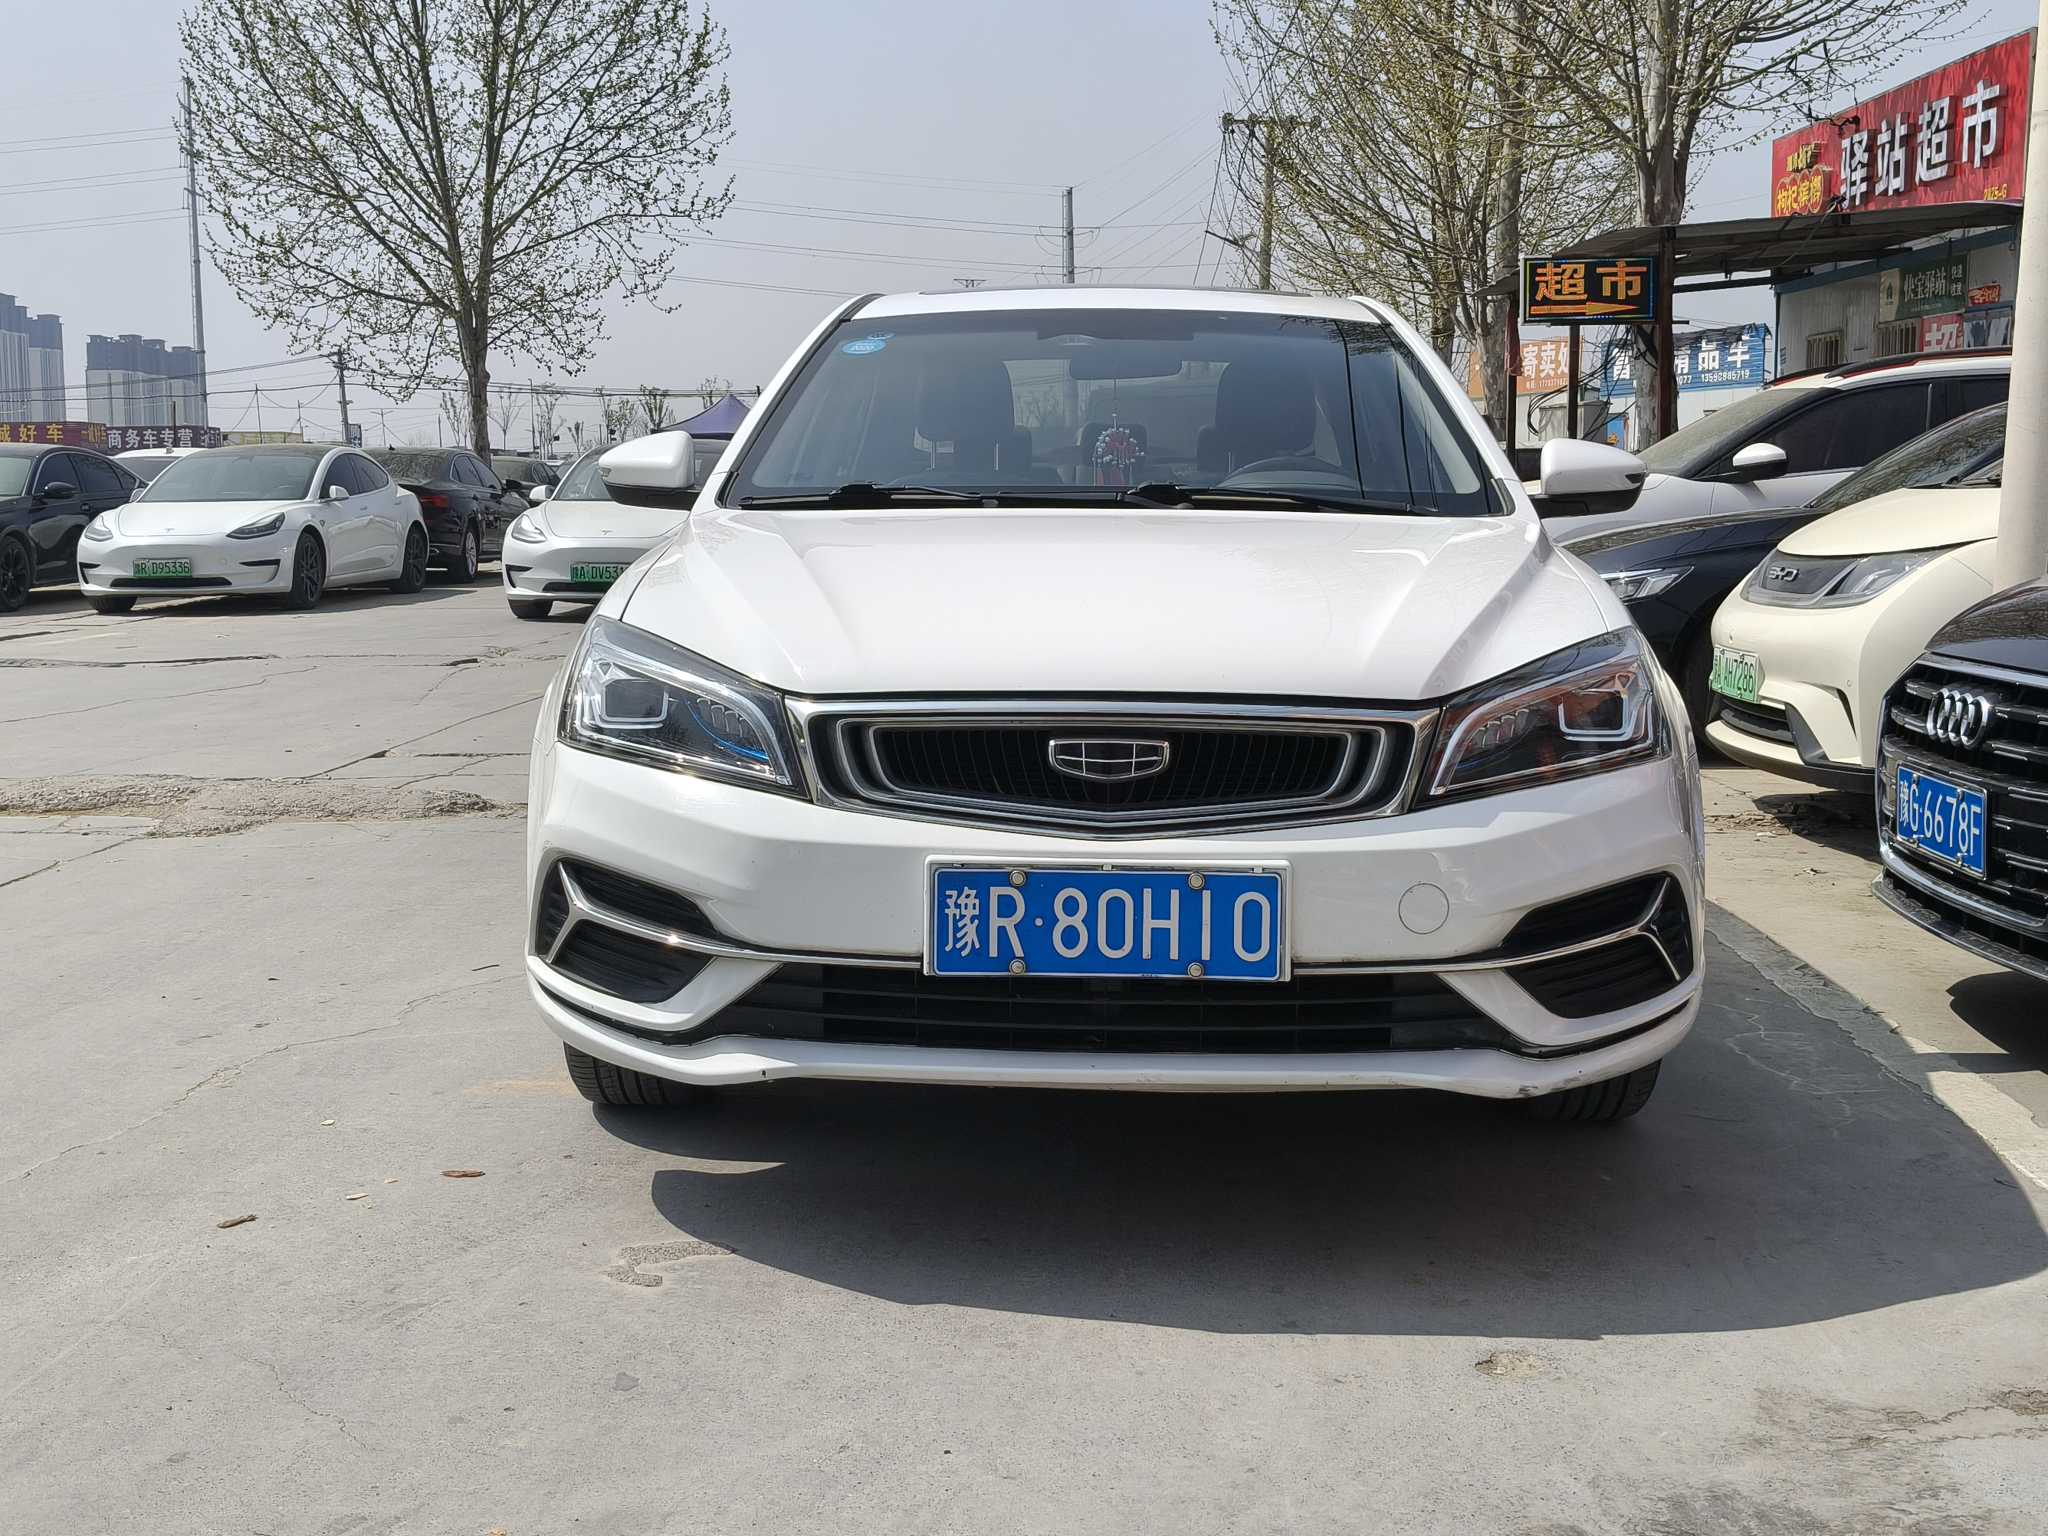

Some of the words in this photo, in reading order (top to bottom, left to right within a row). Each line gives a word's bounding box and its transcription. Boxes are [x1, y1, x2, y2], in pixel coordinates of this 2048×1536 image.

[1840, 80, 2000, 209] 驿站超市
[1535, 261, 1647, 302] 超市
[107, 428, 193, 449] 商务车专营
